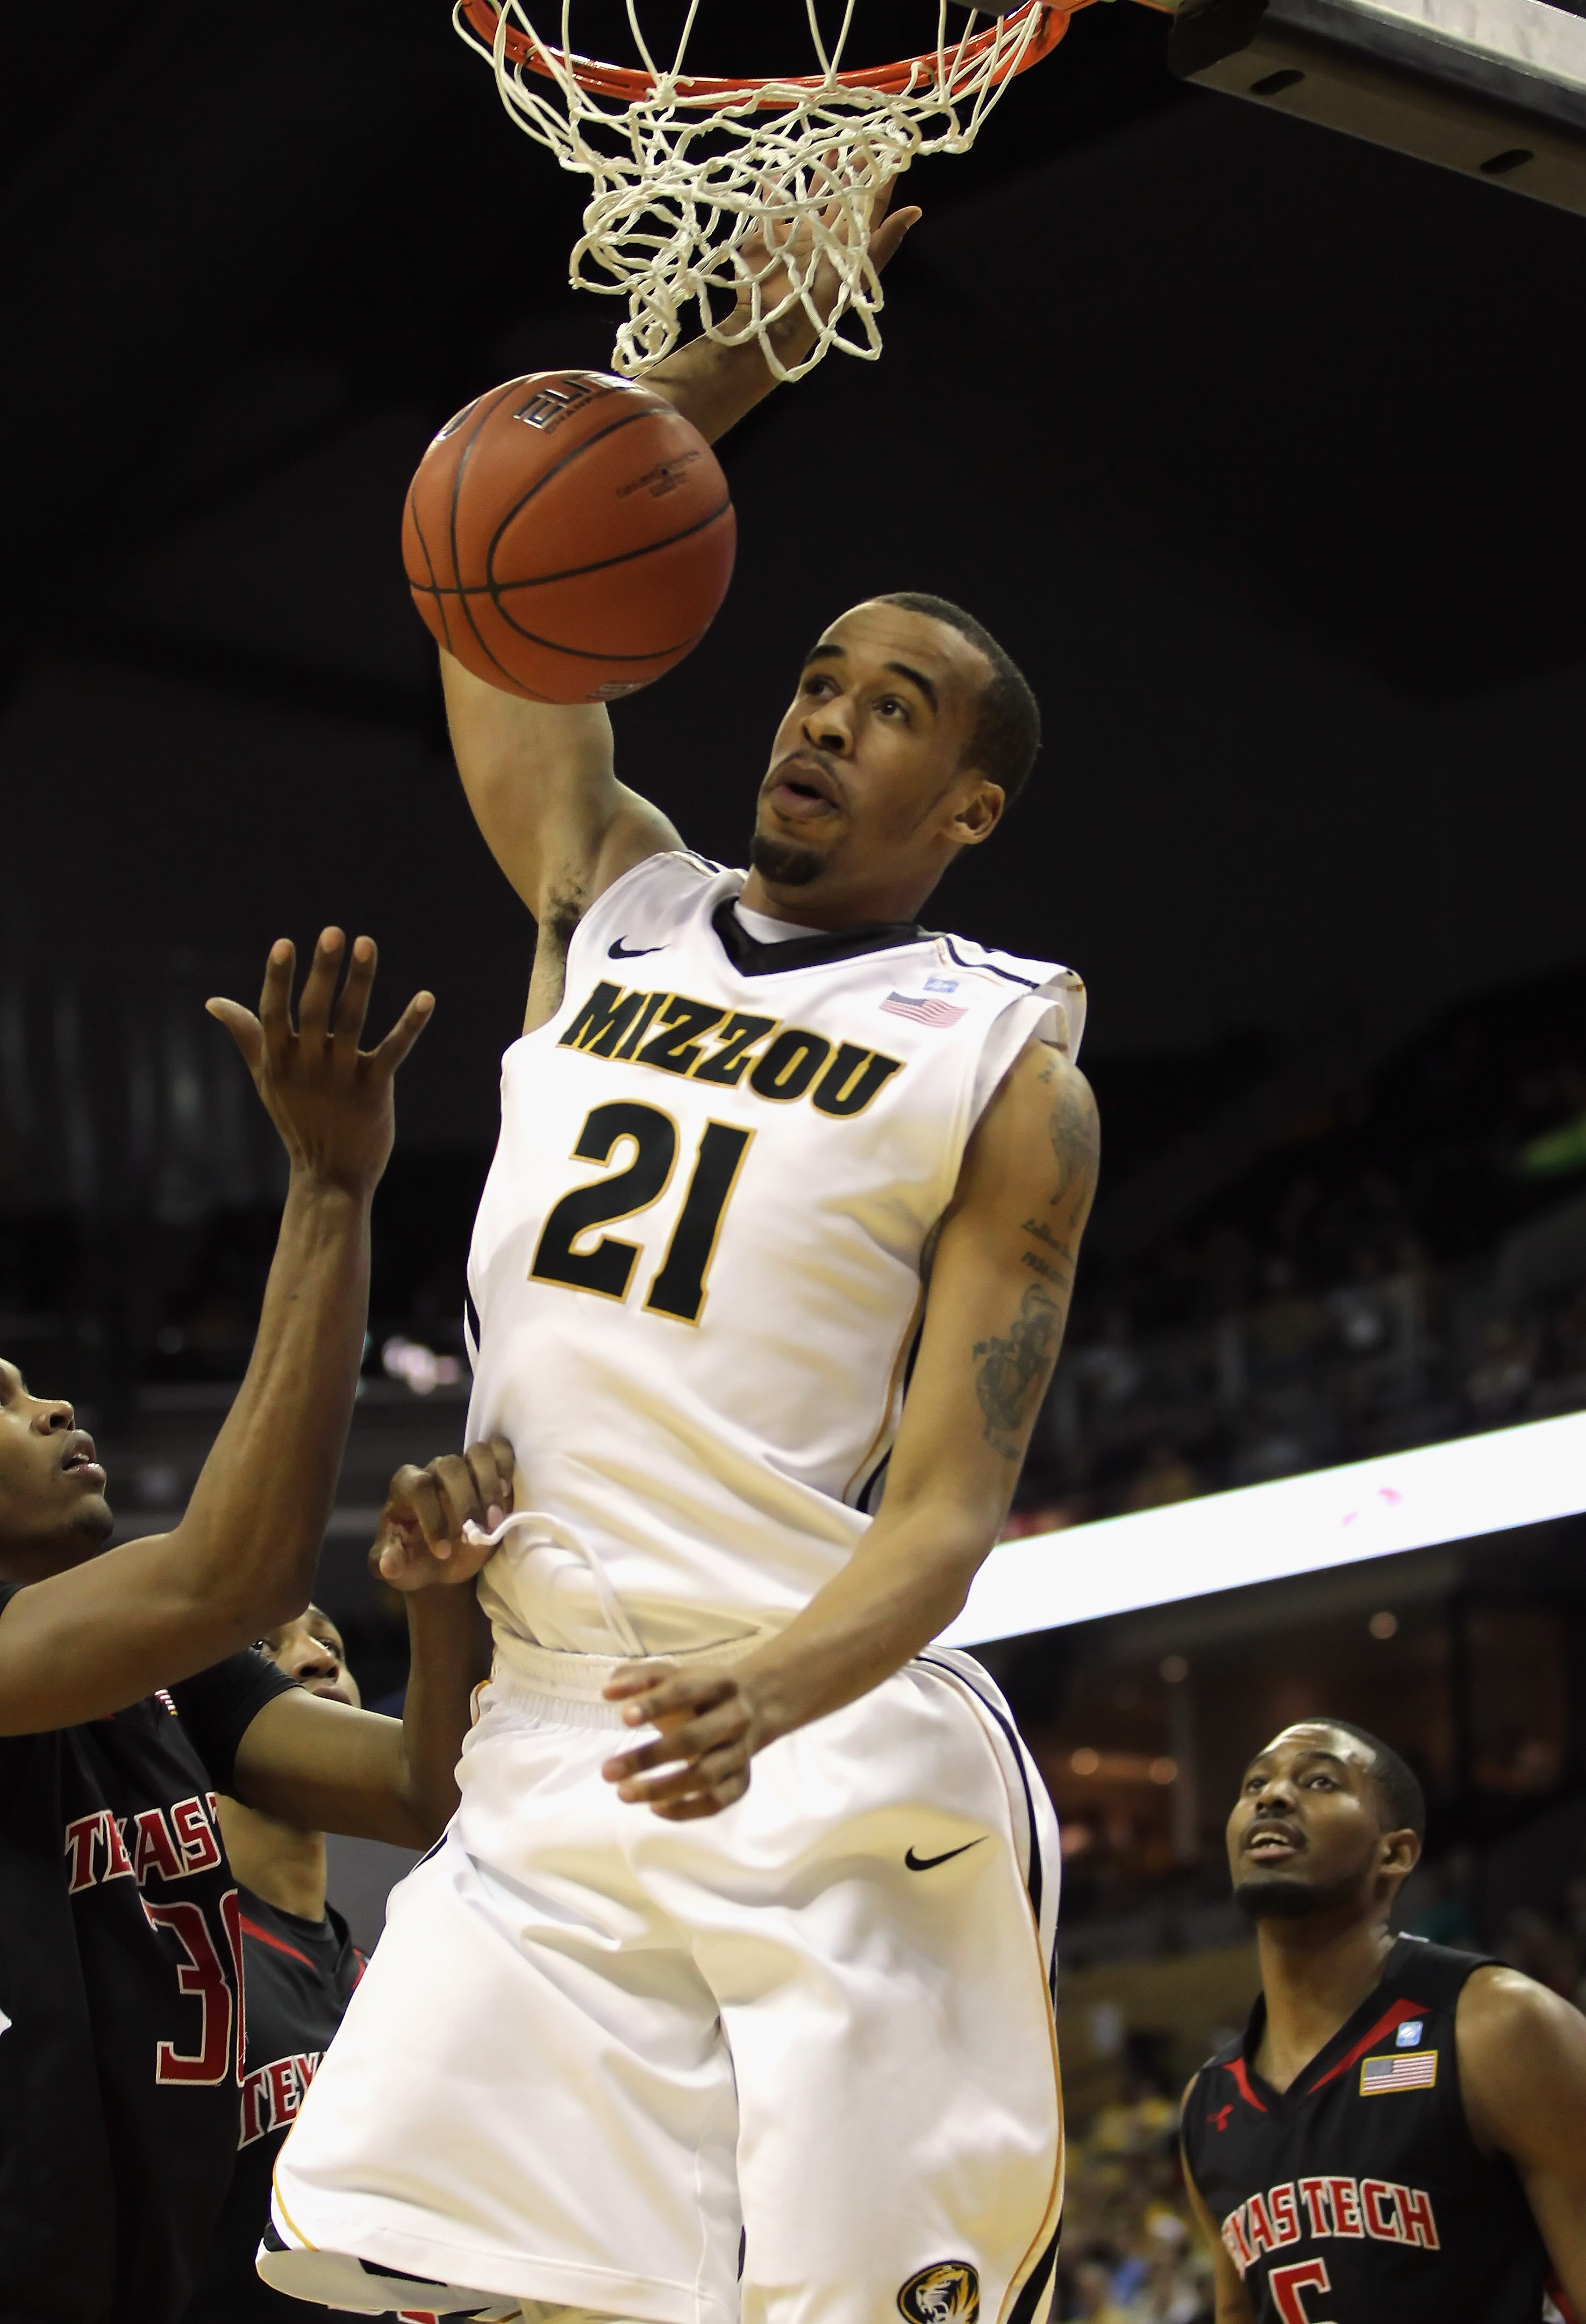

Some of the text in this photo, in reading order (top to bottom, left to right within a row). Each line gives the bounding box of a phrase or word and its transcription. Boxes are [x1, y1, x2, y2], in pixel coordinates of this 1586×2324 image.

[556, 979, 908, 1120] MIZZOU
[527, 1098, 757, 1329] 21
[64, 1795, 222, 1894] TEAS
